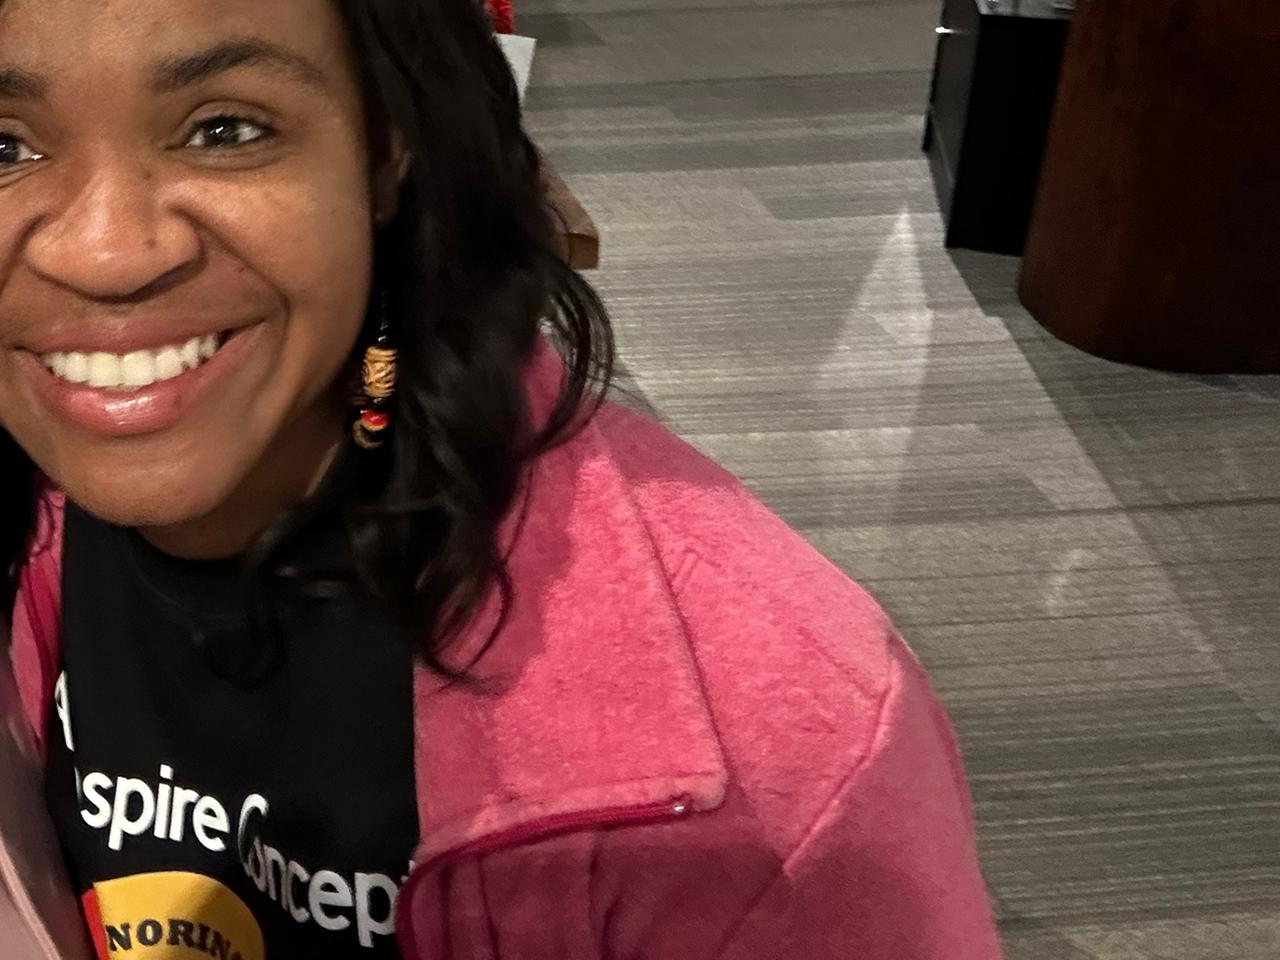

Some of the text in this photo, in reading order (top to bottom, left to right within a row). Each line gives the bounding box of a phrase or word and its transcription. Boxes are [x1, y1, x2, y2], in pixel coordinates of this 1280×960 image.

[74, 763, 417, 948] spire Concep
[105, 918, 243, 960] NORIN
